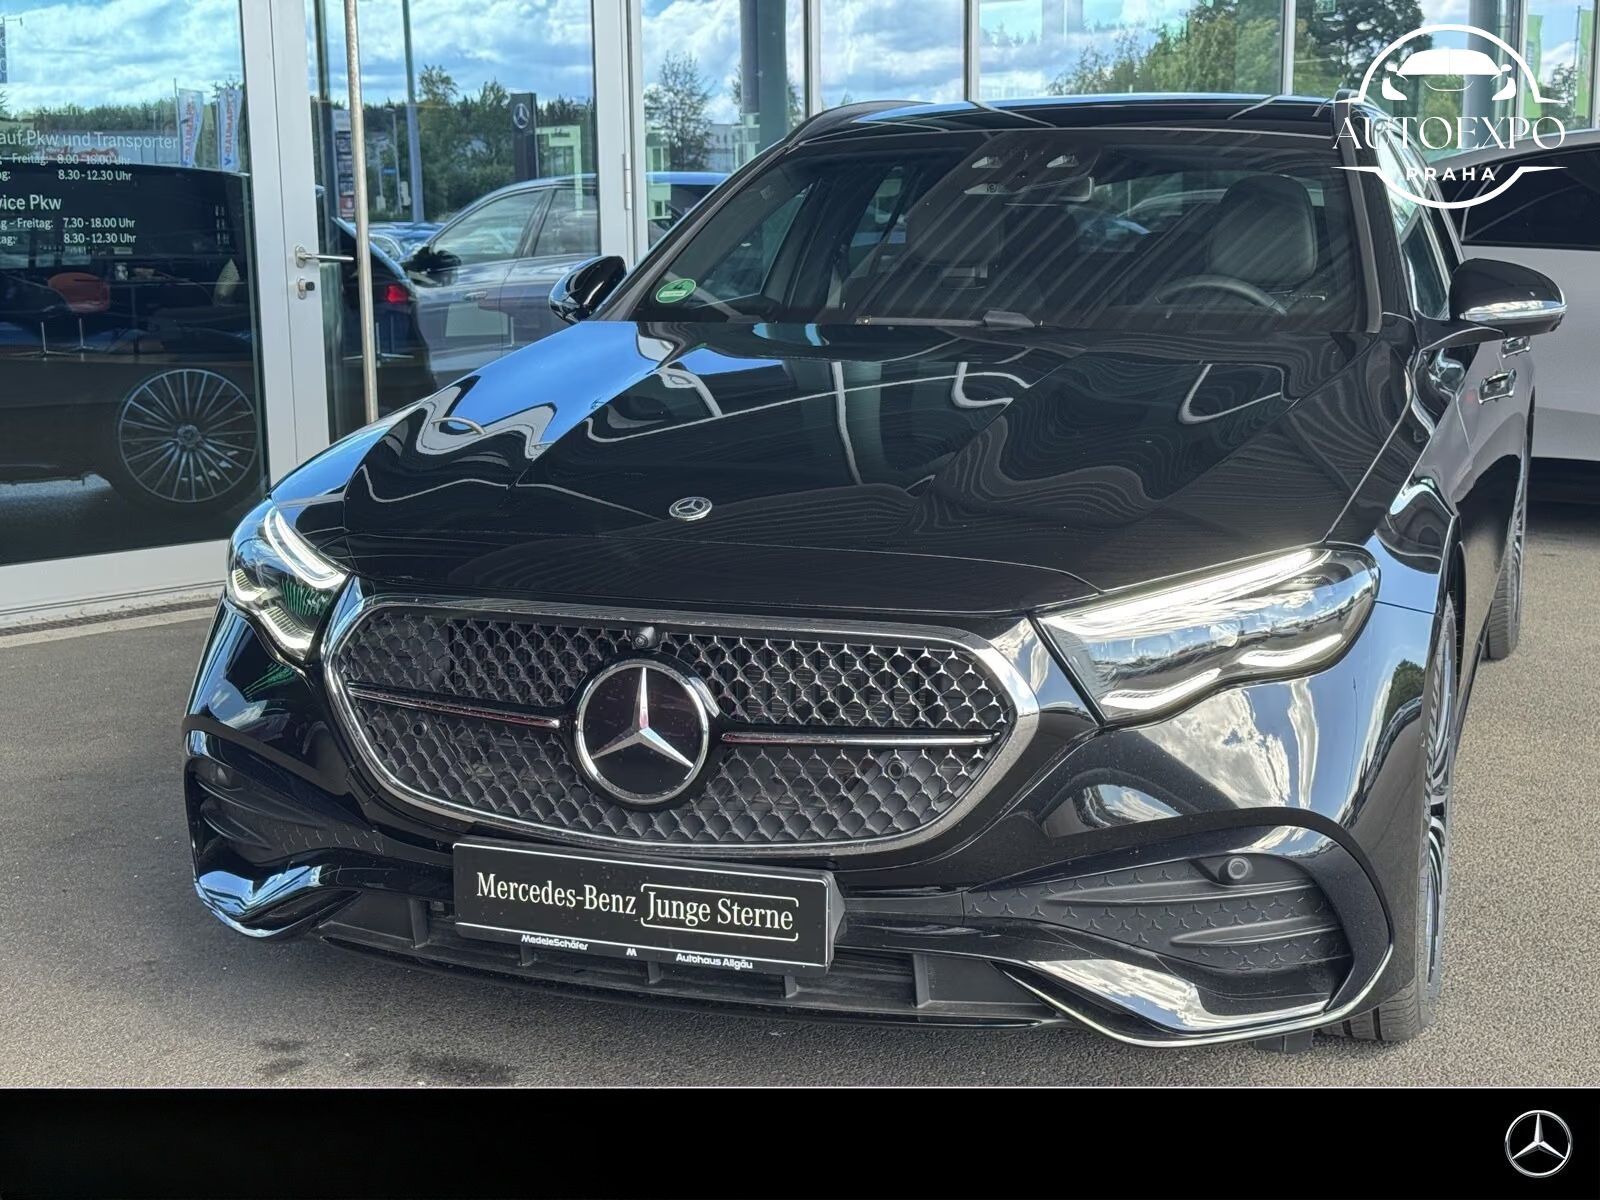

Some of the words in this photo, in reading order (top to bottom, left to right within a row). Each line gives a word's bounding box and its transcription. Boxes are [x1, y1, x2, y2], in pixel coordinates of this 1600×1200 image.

[27, 130, 59, 146] Pkw
[63, 132, 91, 147] und
[94, 131, 178, 151] Transporter
[12, 153, 49, 166] Freitag:
[57, 153, 79, 165] 8.00
[87, 154, 115, 165] 18.00
[58, 169, 80, 180] 8.30
[87, 170, 114, 181] 12.30
[115, 170, 132, 181] Uhr
[29, 194, 62, 210] Pkw
[17, 218, 54, 231] Freitag:
[62, 217, 84, 228] 7.30
[90, 218, 117, 228] 18.00
[118, 218, 136, 229] Uhr
[63, 233, 85, 244] 8.30
[92, 233, 118, 244] 12.30
[120, 234, 136, 244] Uhr
[476, 872, 636, 916] Mercedes-Benz
[646, 890, 711, 926] Junge
[716, 897, 794, 931] Sterne
[676, 952, 722, 966] Autohaus
[722, 957, 754, 970] Allgäu
